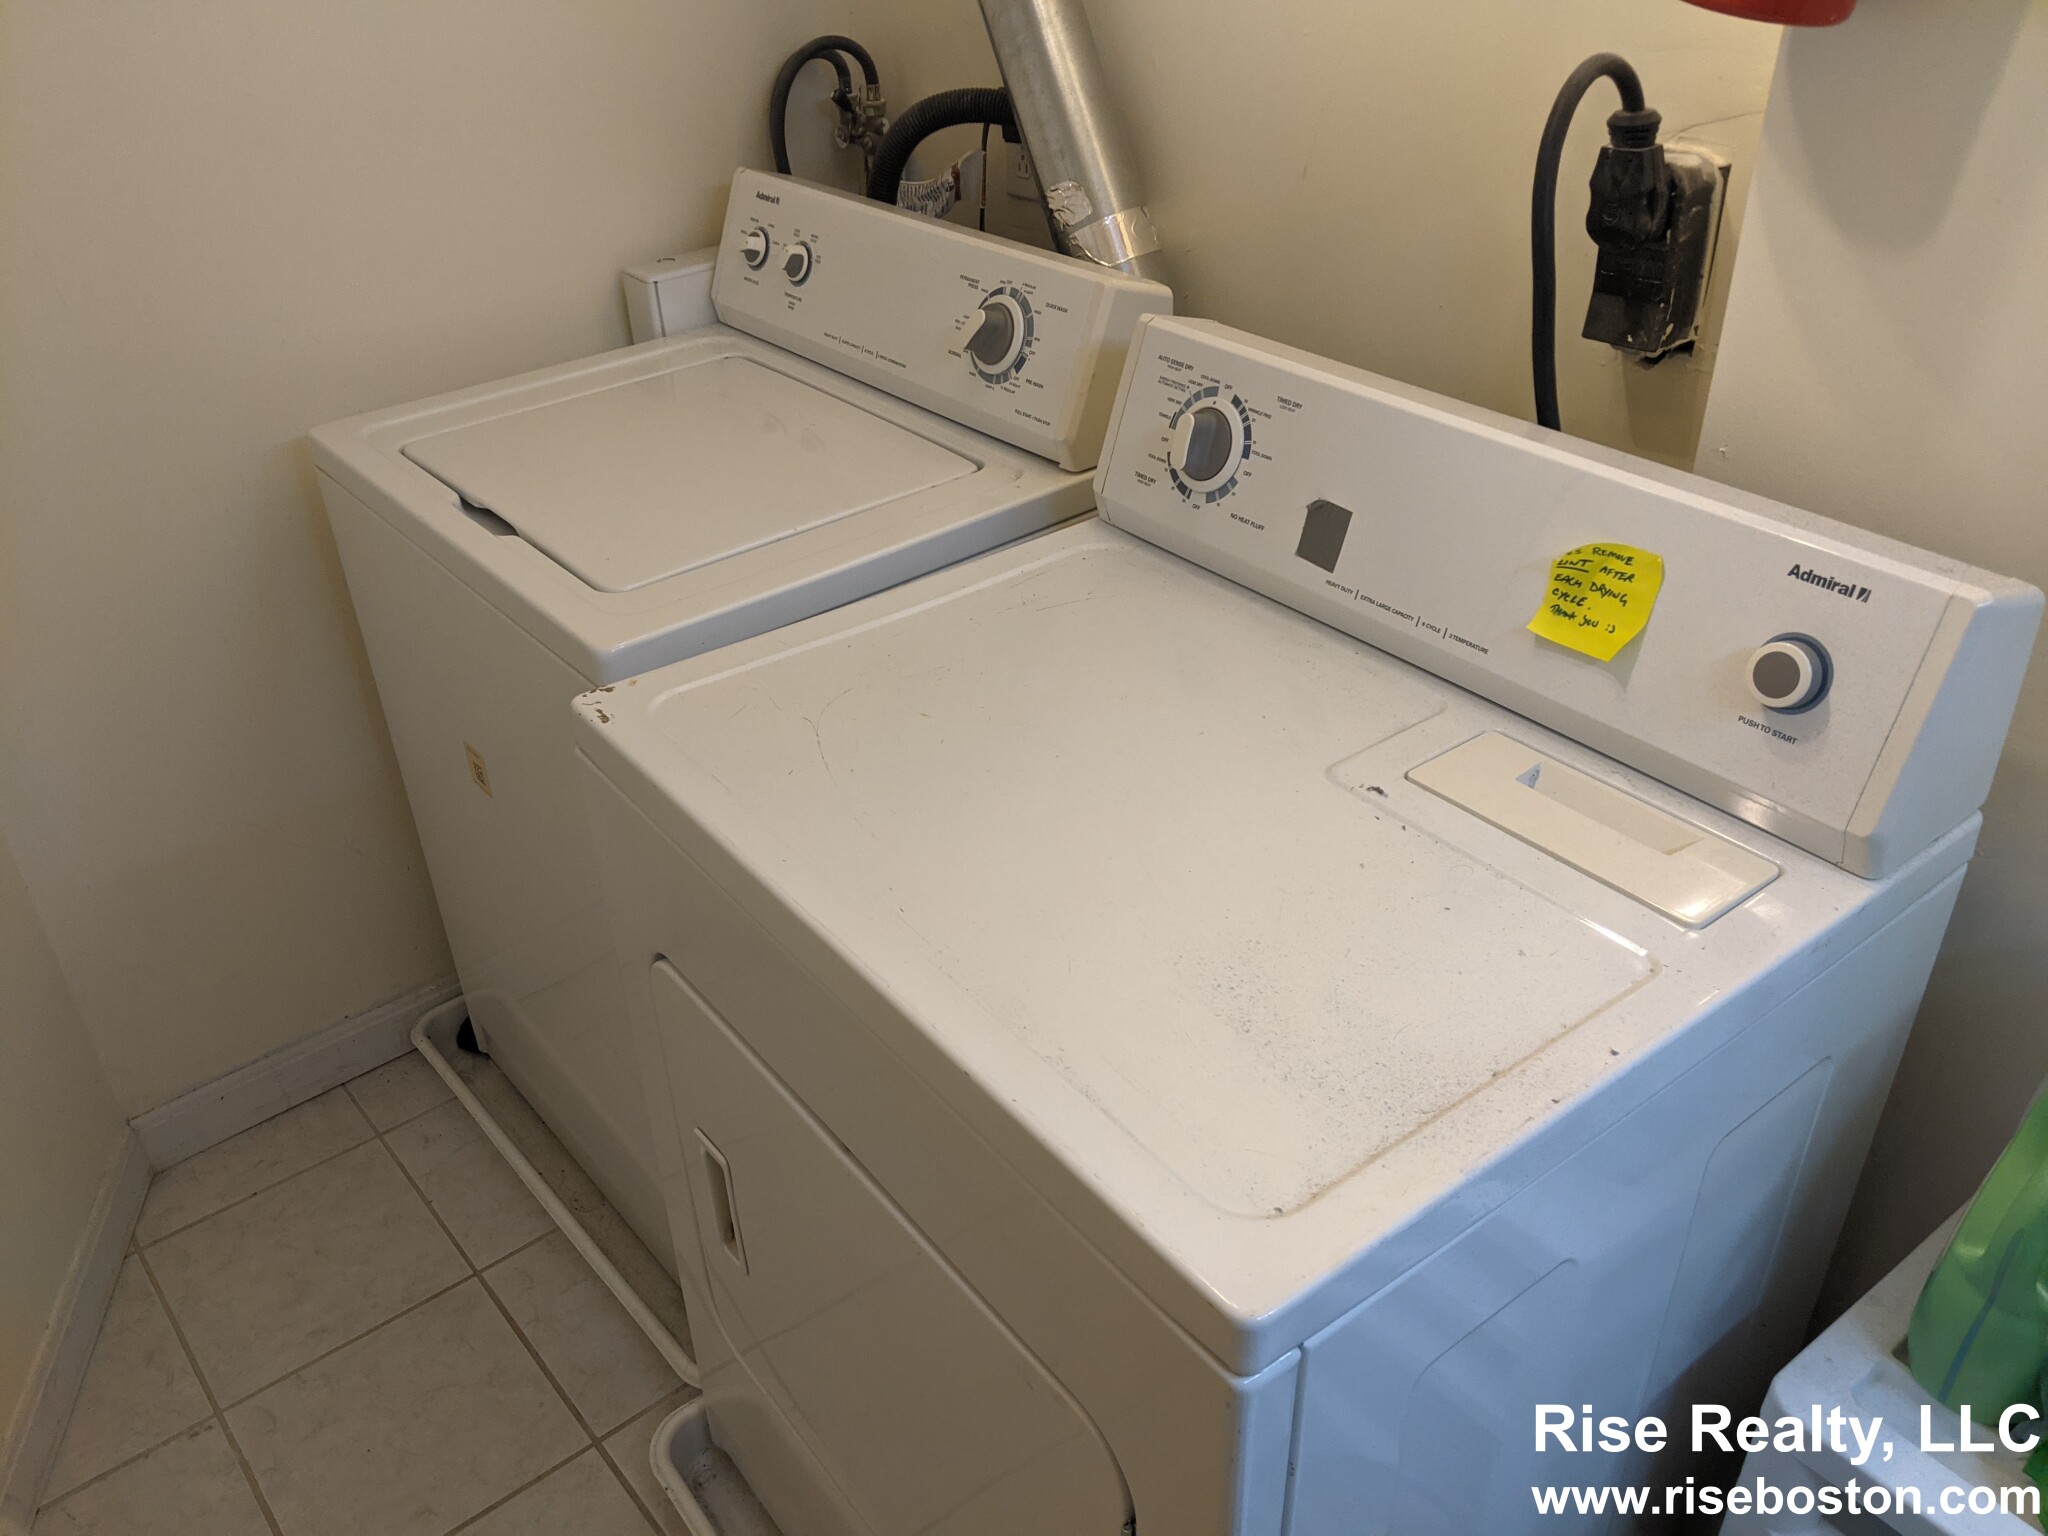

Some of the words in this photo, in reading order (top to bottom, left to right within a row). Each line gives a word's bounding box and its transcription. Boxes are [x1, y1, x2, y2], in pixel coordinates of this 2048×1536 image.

[756, 190, 775, 204] Admiral
[1045, 302, 1056, 310] QUICK
[1056, 305, 1069, 313] WASH
[1158, 354, 1170, 363] AUTO
[1170, 359, 1185, 368] SENSE
[1185, 363, 1194, 371] DRY
[1277, 396, 1292, 405] TIMED
[1134, 470, 1147, 482] TIMED
[1147, 476, 1156, 485] DRY
[1192, 503, 1201, 511] OFF
[1230, 512, 1238, 520] NO
[1237, 515, 1250, 525] HEAT
[1250, 521, 1265, 532] FLUFF
[1593, 547, 1635, 566] REMOVE
[1557, 559, 1594, 570] LINT
[1599, 566, 1635, 583] AFTER
[1325, 579, 1341, 590] HEAVY
[1340, 585, 1353, 594] DUTY
[1554, 573, 1583, 588] EACH
[1589, 581, 1628, 607] DRYING
[1787, 563, 1856, 599] Admiral
[1360, 594, 1376, 605] EXTRA
[1375, 600, 1391, 612] LARGE
[1391, 608, 1414, 622] CAPACITY
[1426, 622, 1441, 634] CYCLE
[1452, 634, 1489, 655] TEMPERATURE
[1737, 715, 1759, 730] PUSH
[1759, 724, 1771, 734] TO
[1771, 729, 1798, 745] START
